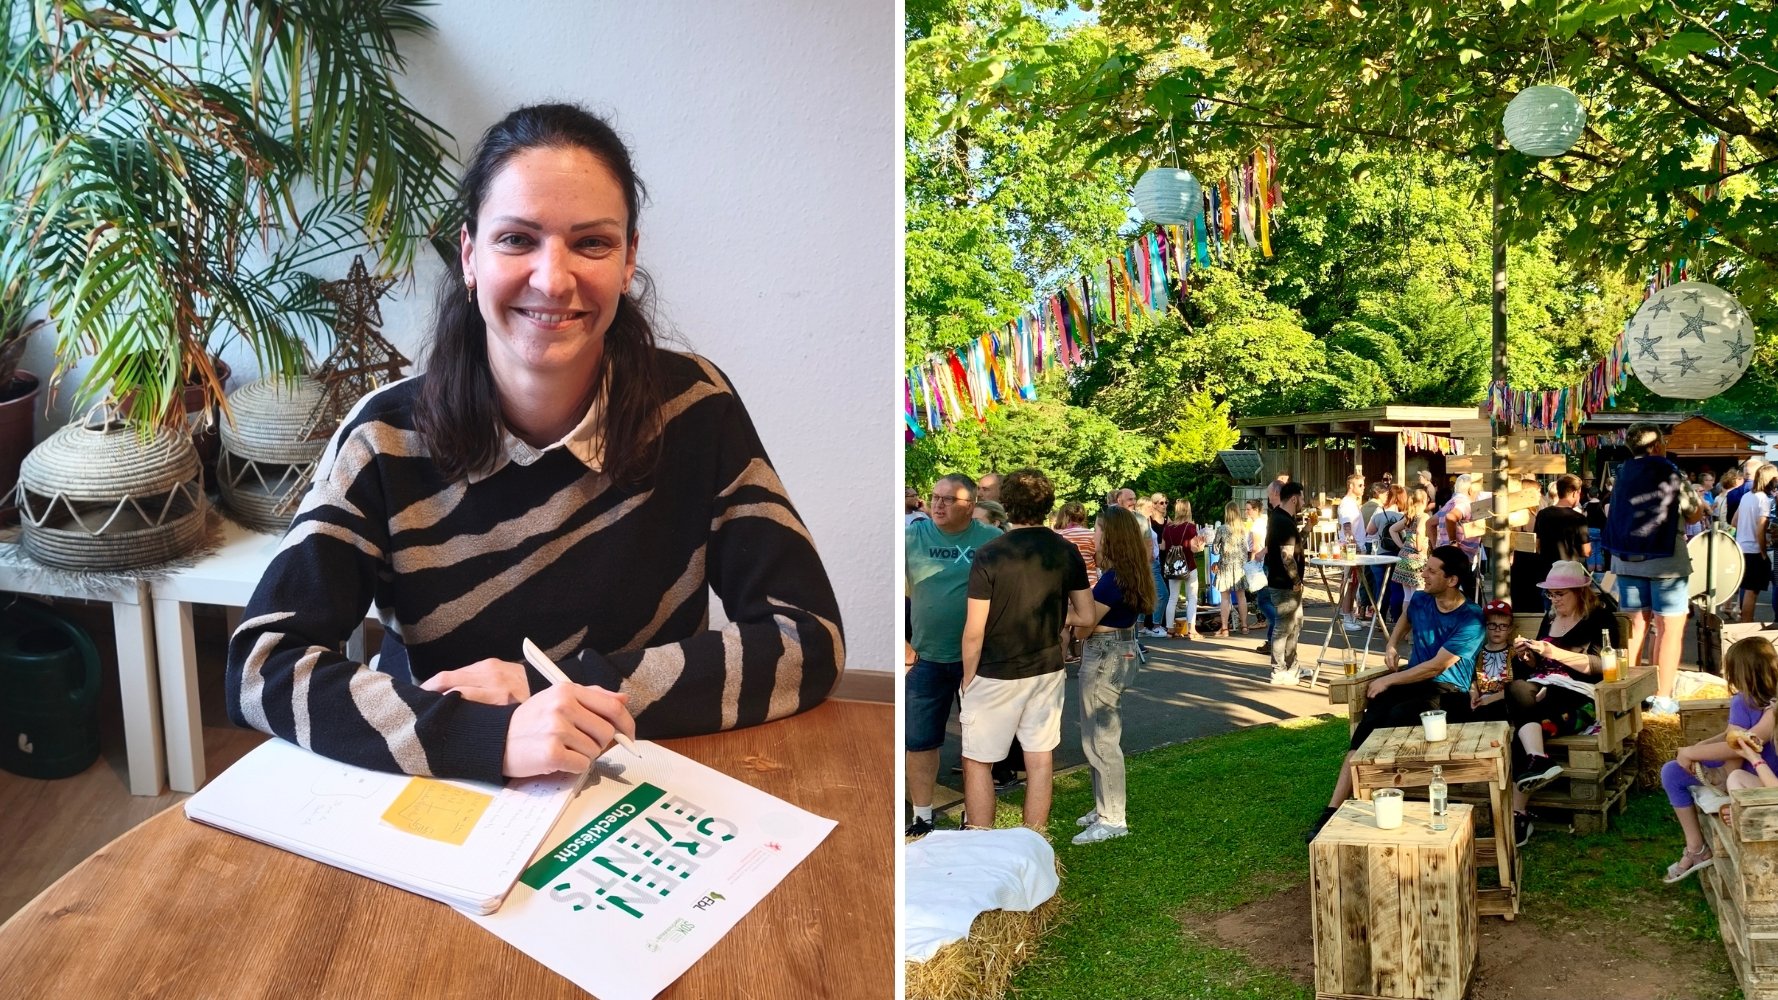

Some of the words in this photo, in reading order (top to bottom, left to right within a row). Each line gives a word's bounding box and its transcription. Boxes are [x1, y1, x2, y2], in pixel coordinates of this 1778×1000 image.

[549, 795, 706, 912] EVENTS
[553, 803, 636, 863] Checklëscht
[692, 895, 716, 911] EbL
